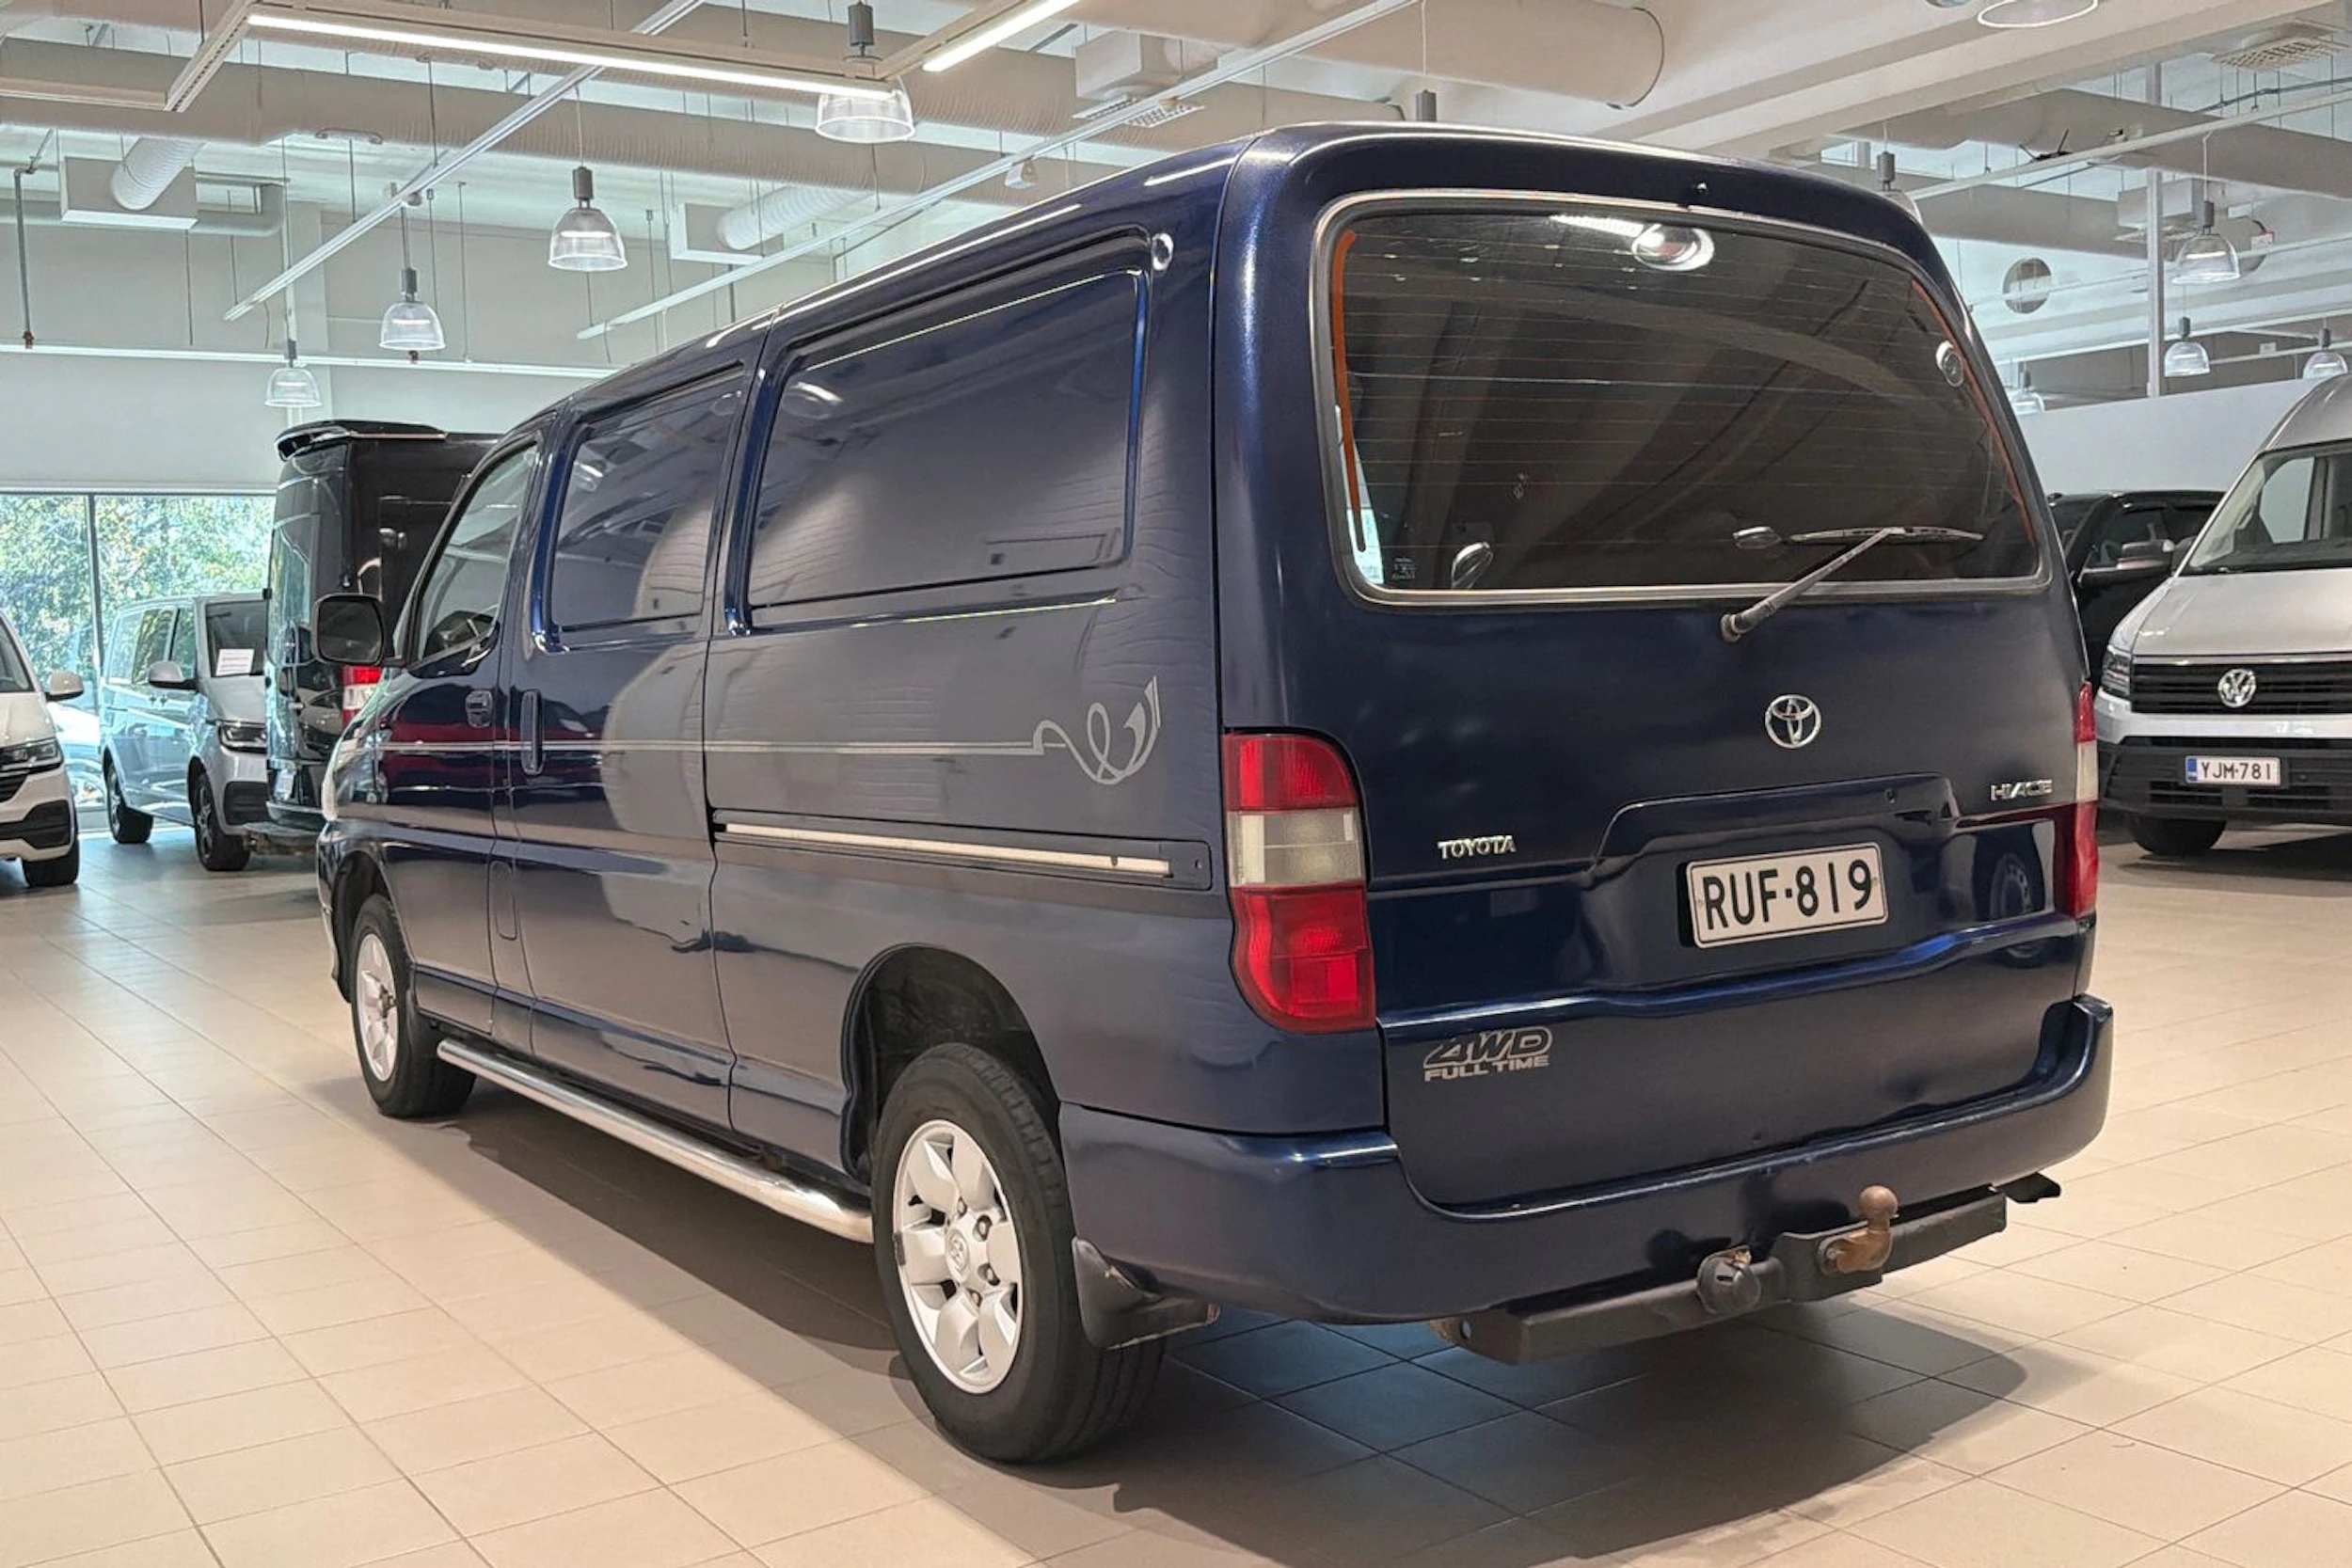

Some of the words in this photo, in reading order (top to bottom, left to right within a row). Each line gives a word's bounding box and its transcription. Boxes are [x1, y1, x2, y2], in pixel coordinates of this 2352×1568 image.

[1990, 779, 2053, 801] HIACE
[1437, 835, 1517, 860] TOYOTA
[1423, 1026, 1552, 1069] 4WD
[1423, 1063, 1489, 1083] FULL
[1492, 1054, 1550, 1072] TIME
